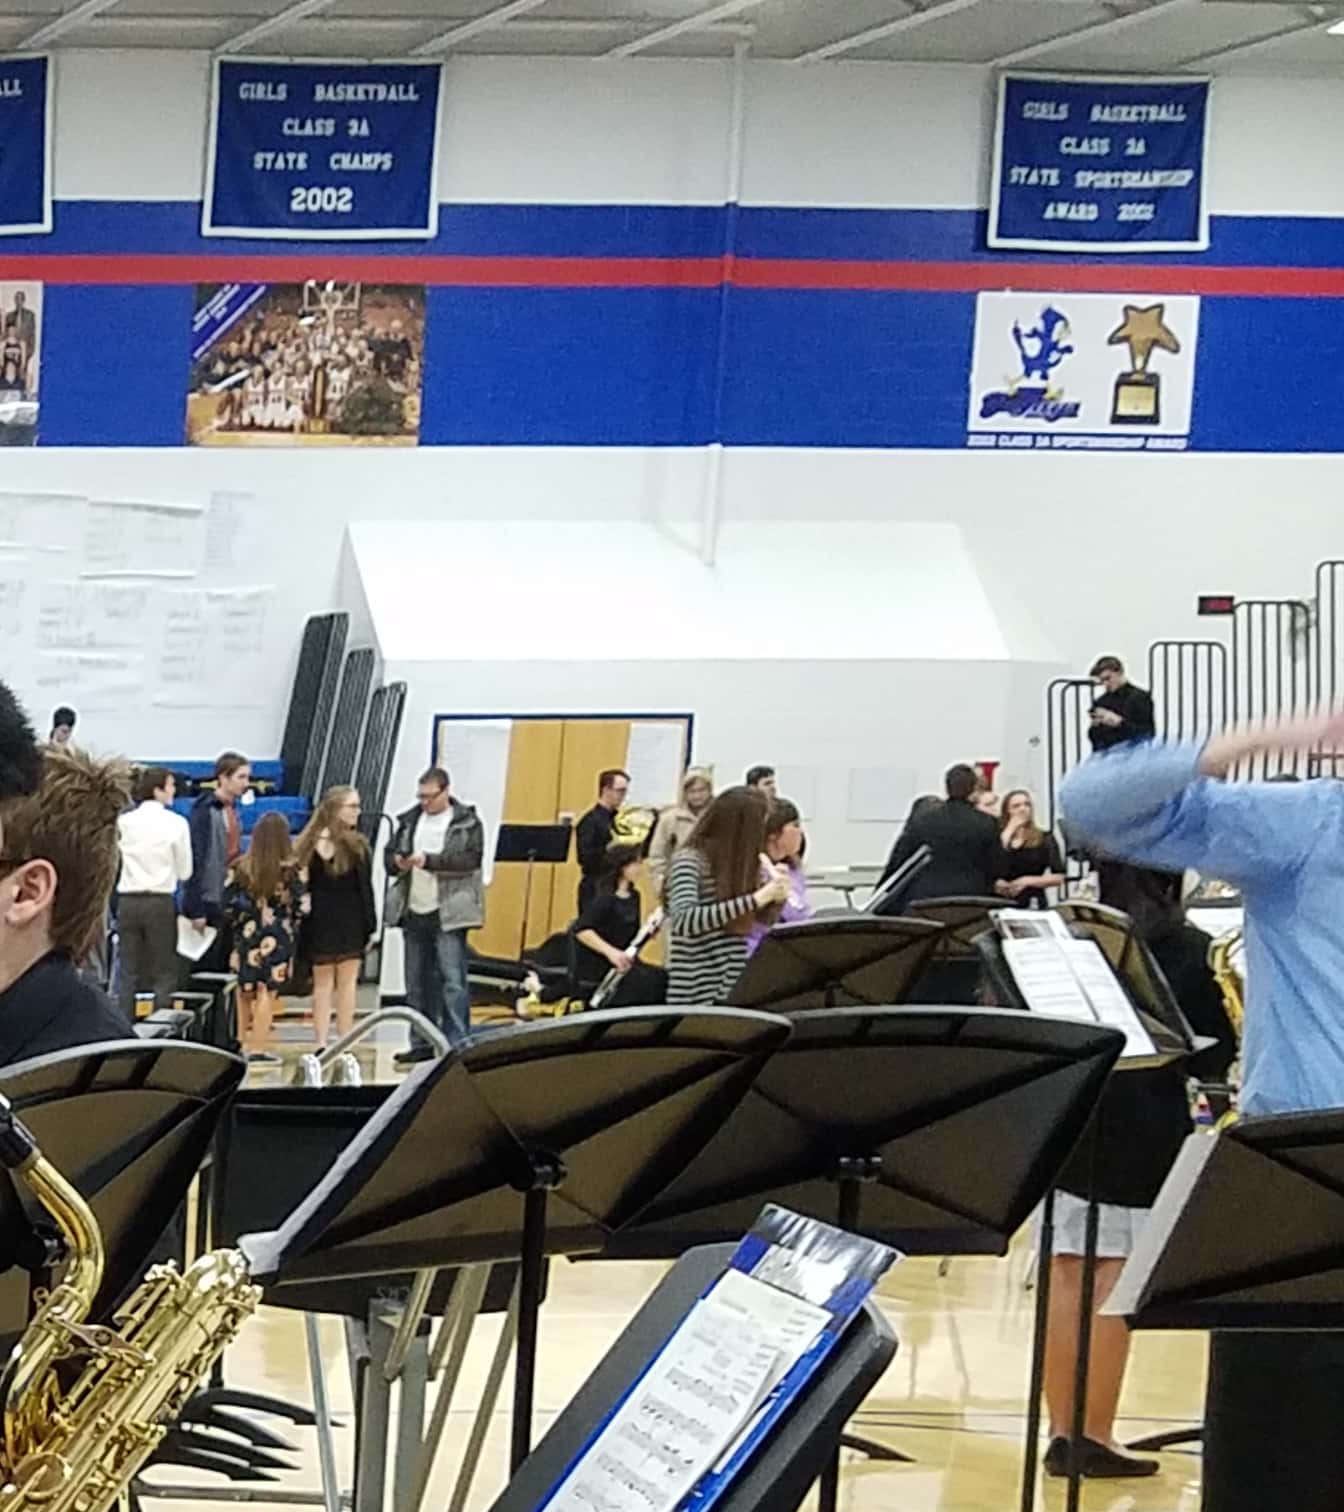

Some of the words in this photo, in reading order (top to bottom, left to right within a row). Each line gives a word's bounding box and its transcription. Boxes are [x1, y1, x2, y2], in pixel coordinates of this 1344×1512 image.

[239, 83, 288, 101] GIRLS
[314, 83, 420, 101] BASKETBALL
[282, 117, 336, 136] CLASS
[348, 118, 370, 136] 3A
[1060, 136, 1111, 155] CLASS
[254, 152, 308, 170] STATE
[329, 152, 393, 171] CHAMPS
[1009, 166, 1060, 186] STATE
[290, 186, 354, 212] 2002
